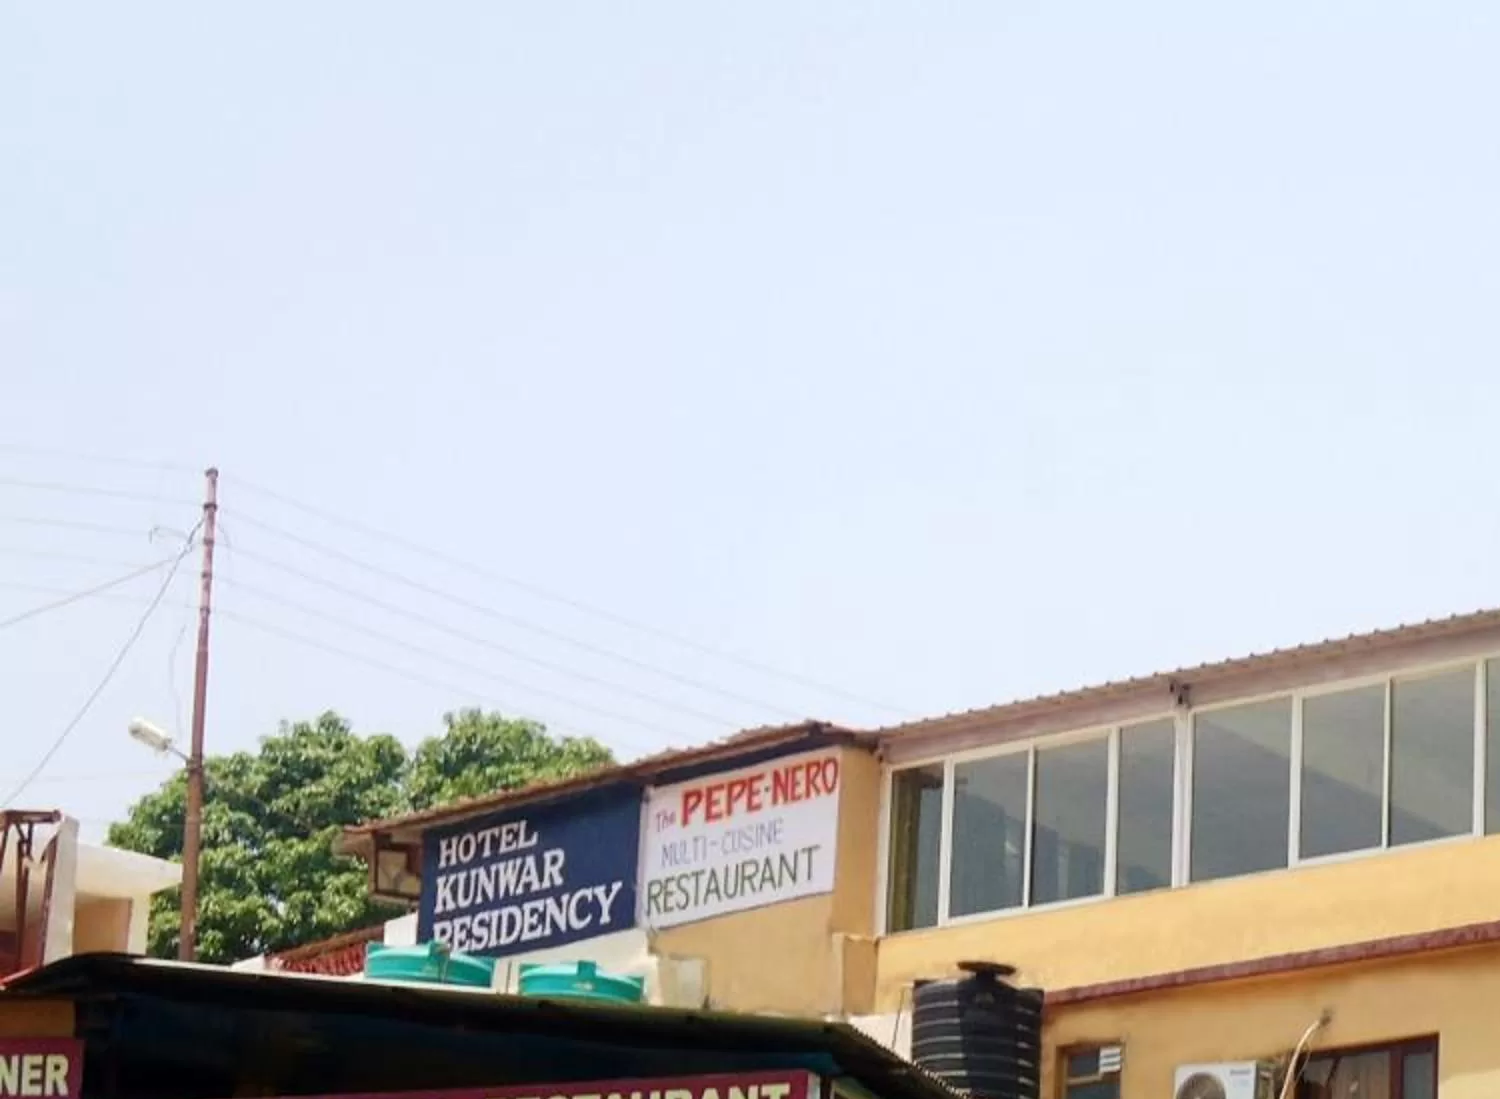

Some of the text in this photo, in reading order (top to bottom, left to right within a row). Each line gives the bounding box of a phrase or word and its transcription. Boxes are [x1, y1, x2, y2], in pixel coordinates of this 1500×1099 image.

[438, 820, 539, 868] HOTEL
[434, 848, 565, 914] KUNWAR
[645, 845, 821, 917] RESTAURANT
[433, 881, 623, 953] RESIDENCY
